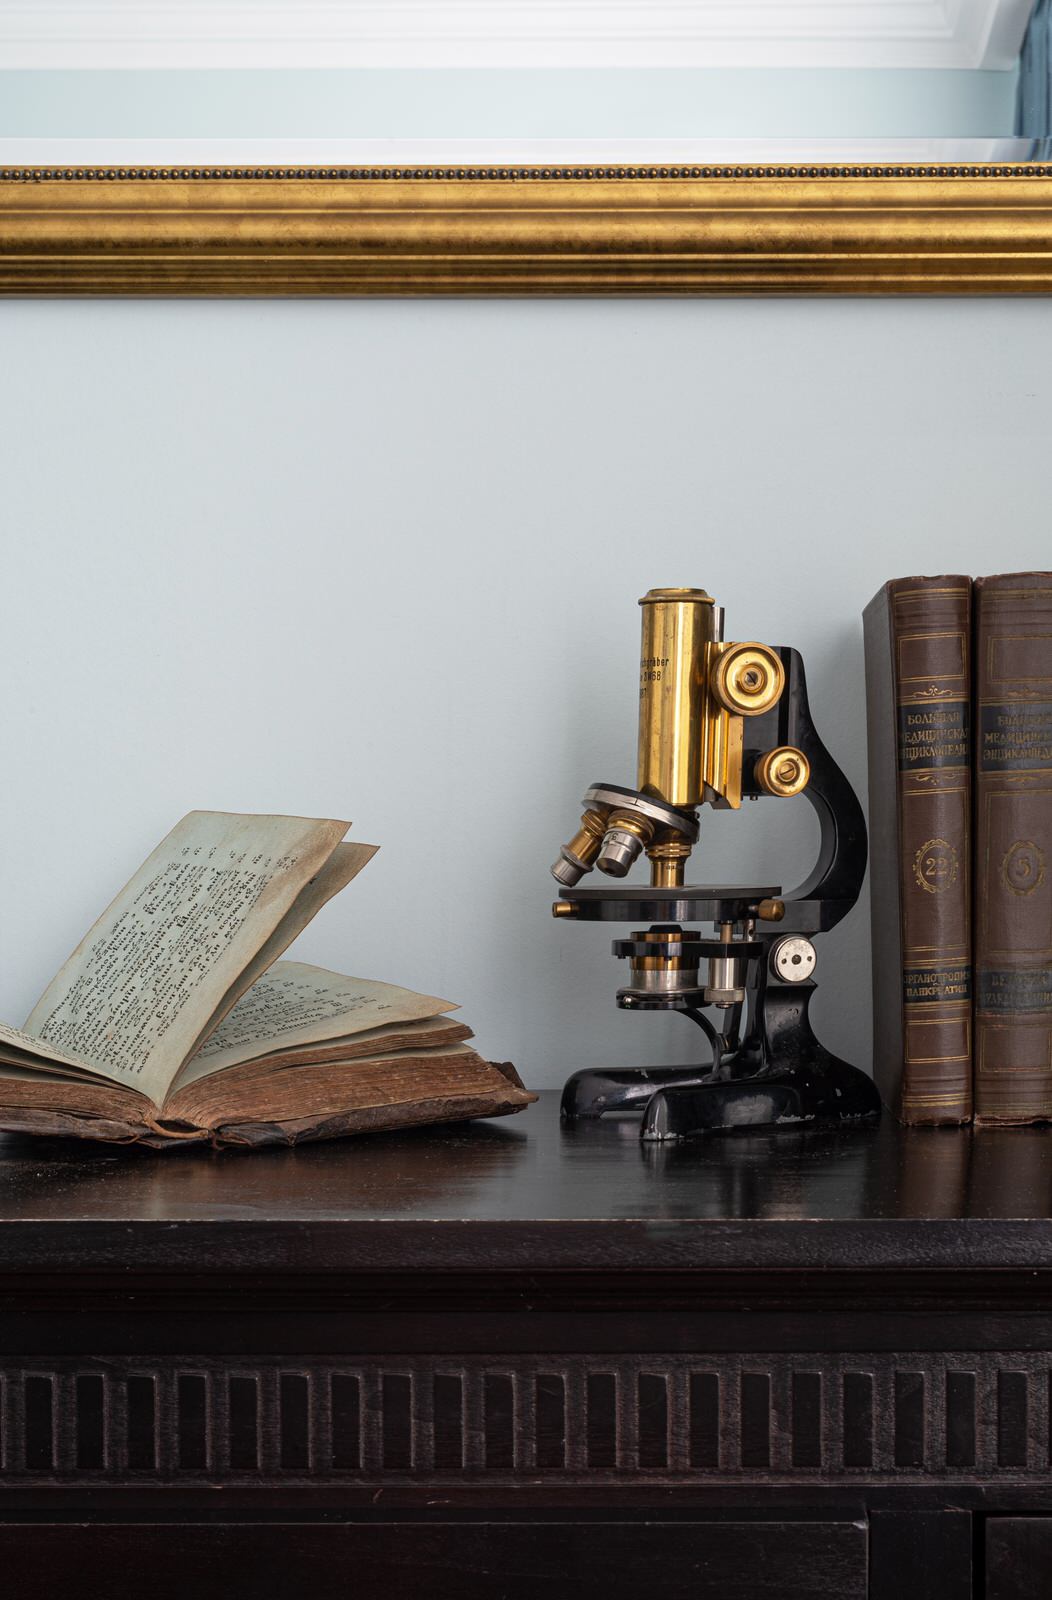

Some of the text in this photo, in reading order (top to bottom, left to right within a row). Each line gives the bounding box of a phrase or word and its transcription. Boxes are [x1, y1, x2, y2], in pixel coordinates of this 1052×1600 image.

[907, 712, 960, 725] БОЛЬШАЯ
[998, 715, 1052, 726] БОЛЬ
[904, 728, 968, 744] ЕДИЦИНСКА
[985, 732, 1052, 744] МЕДИЦИН
[903, 744, 967, 760] НЦИКЛОПЕДИ
[984, 748, 1052, 760] ЭНЦИКЛОПЕД
[926, 858, 947, 875] 22
[1017, 858, 1031, 876] 5
[904, 972, 968, 985] РГАНОТРОПИ
